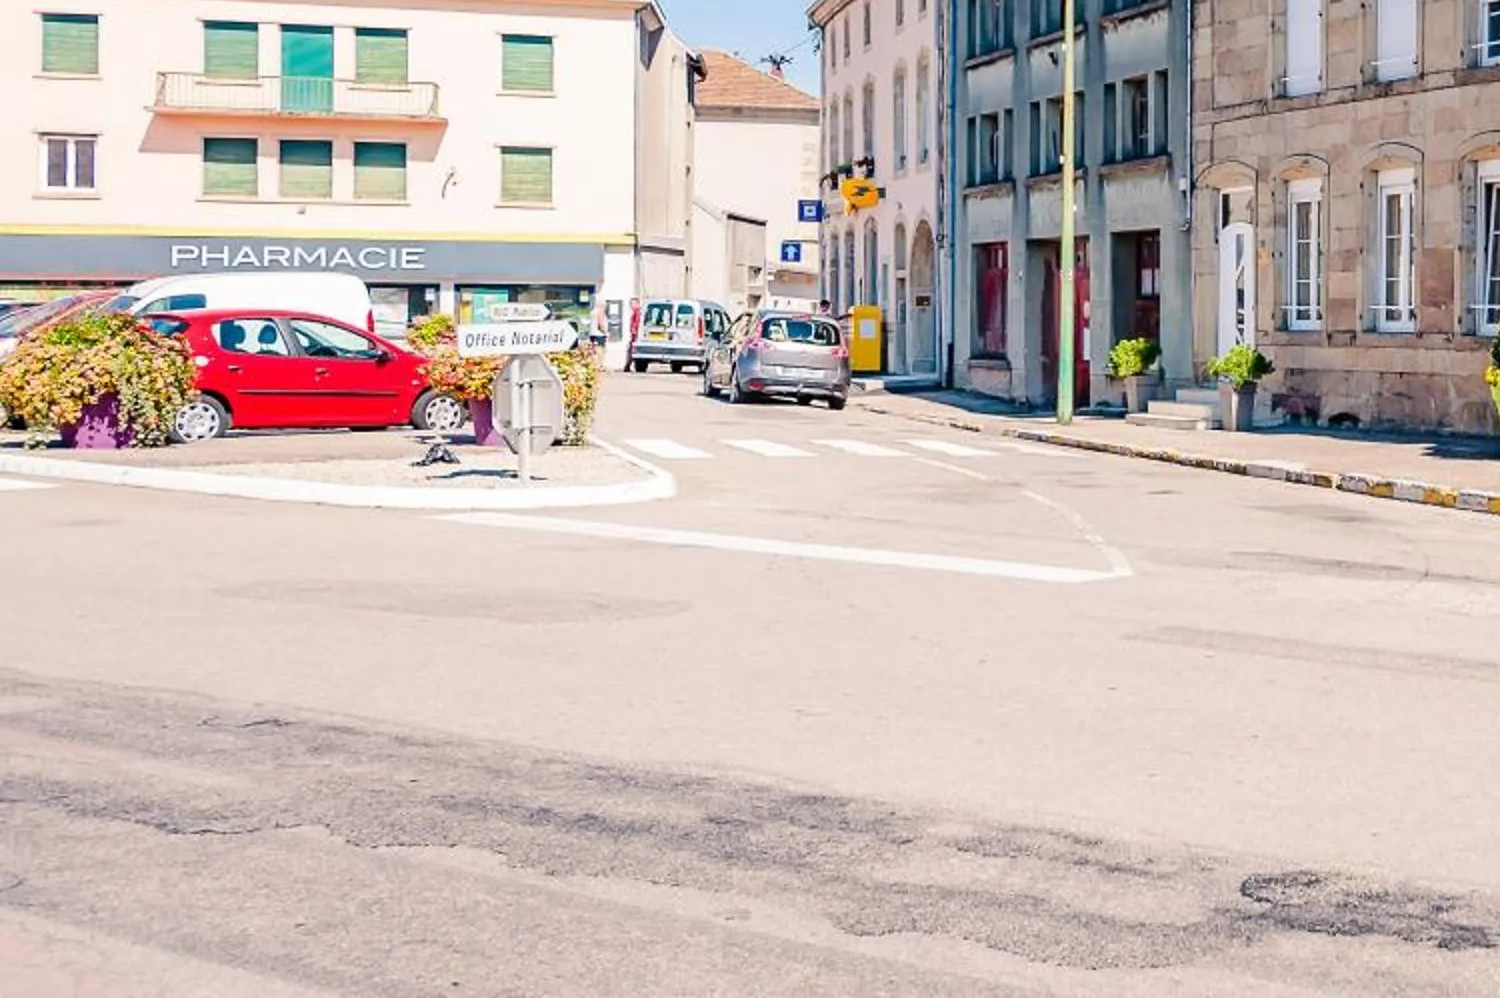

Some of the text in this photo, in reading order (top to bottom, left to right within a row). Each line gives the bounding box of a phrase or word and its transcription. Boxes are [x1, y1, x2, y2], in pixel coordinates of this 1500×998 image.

[170, 245, 426, 269] PHARMACIE
[465, 330, 566, 348] Office Notarial
